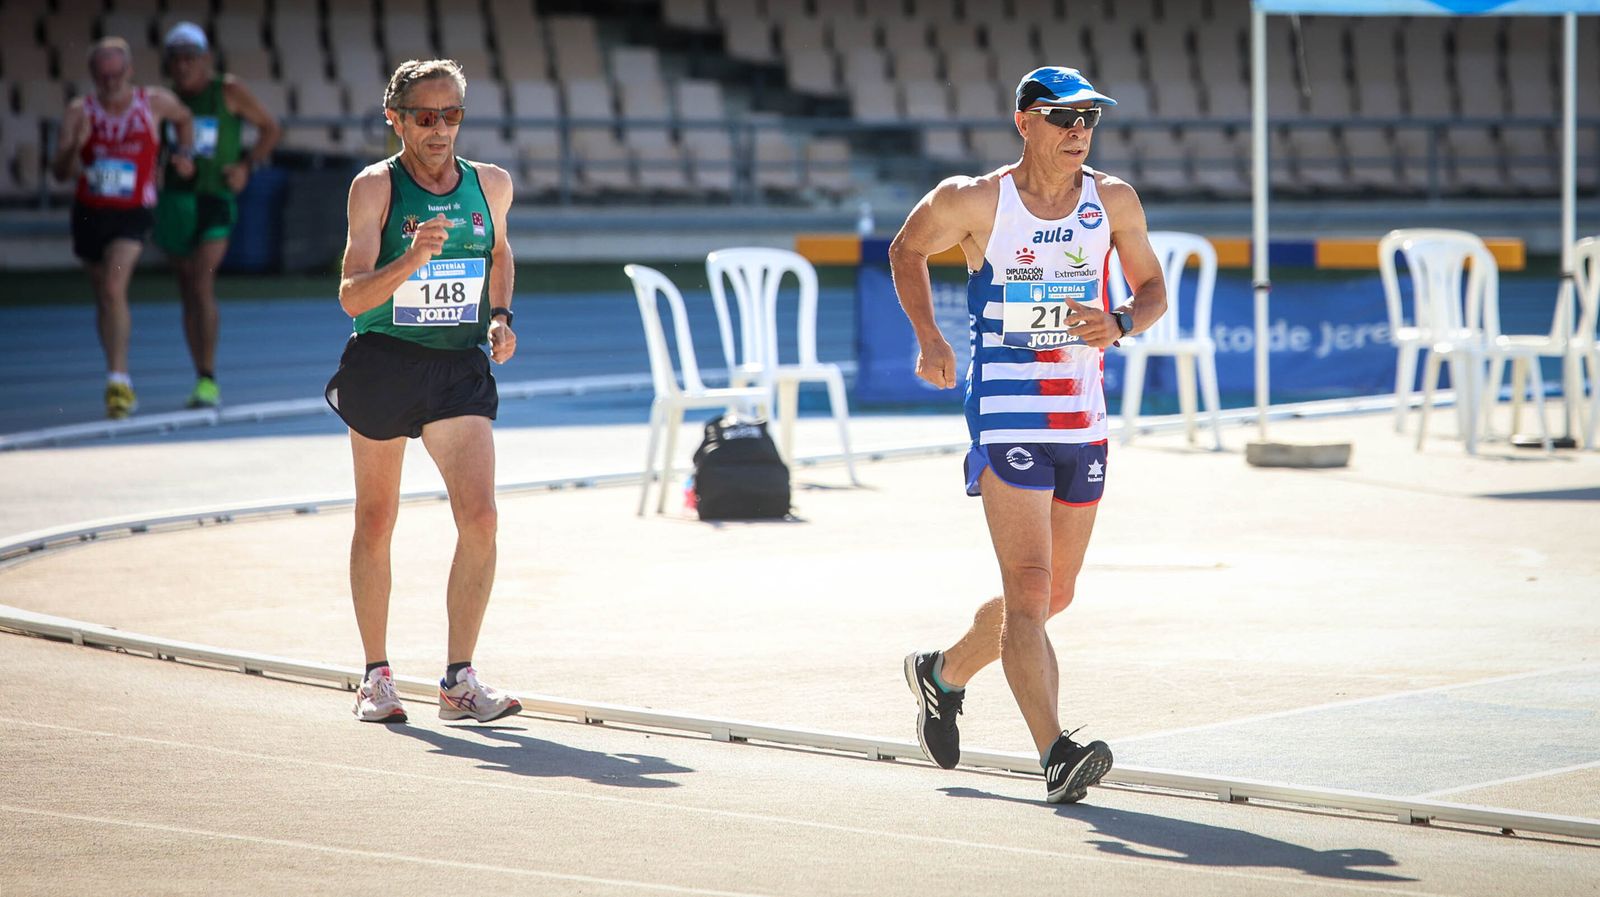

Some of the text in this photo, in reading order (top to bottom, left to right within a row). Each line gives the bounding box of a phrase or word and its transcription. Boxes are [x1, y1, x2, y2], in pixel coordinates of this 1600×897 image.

[428, 203, 452, 211] luanvi
[1032, 227, 1074, 243] aula
[1006, 267, 1044, 275] DIPUTACIÓN
[420, 282, 466, 304] 148
[1048, 284, 1086, 293] LOTERÍAS
[1269, 318, 1312, 353] de
[1314, 320, 1395, 359] Jere
